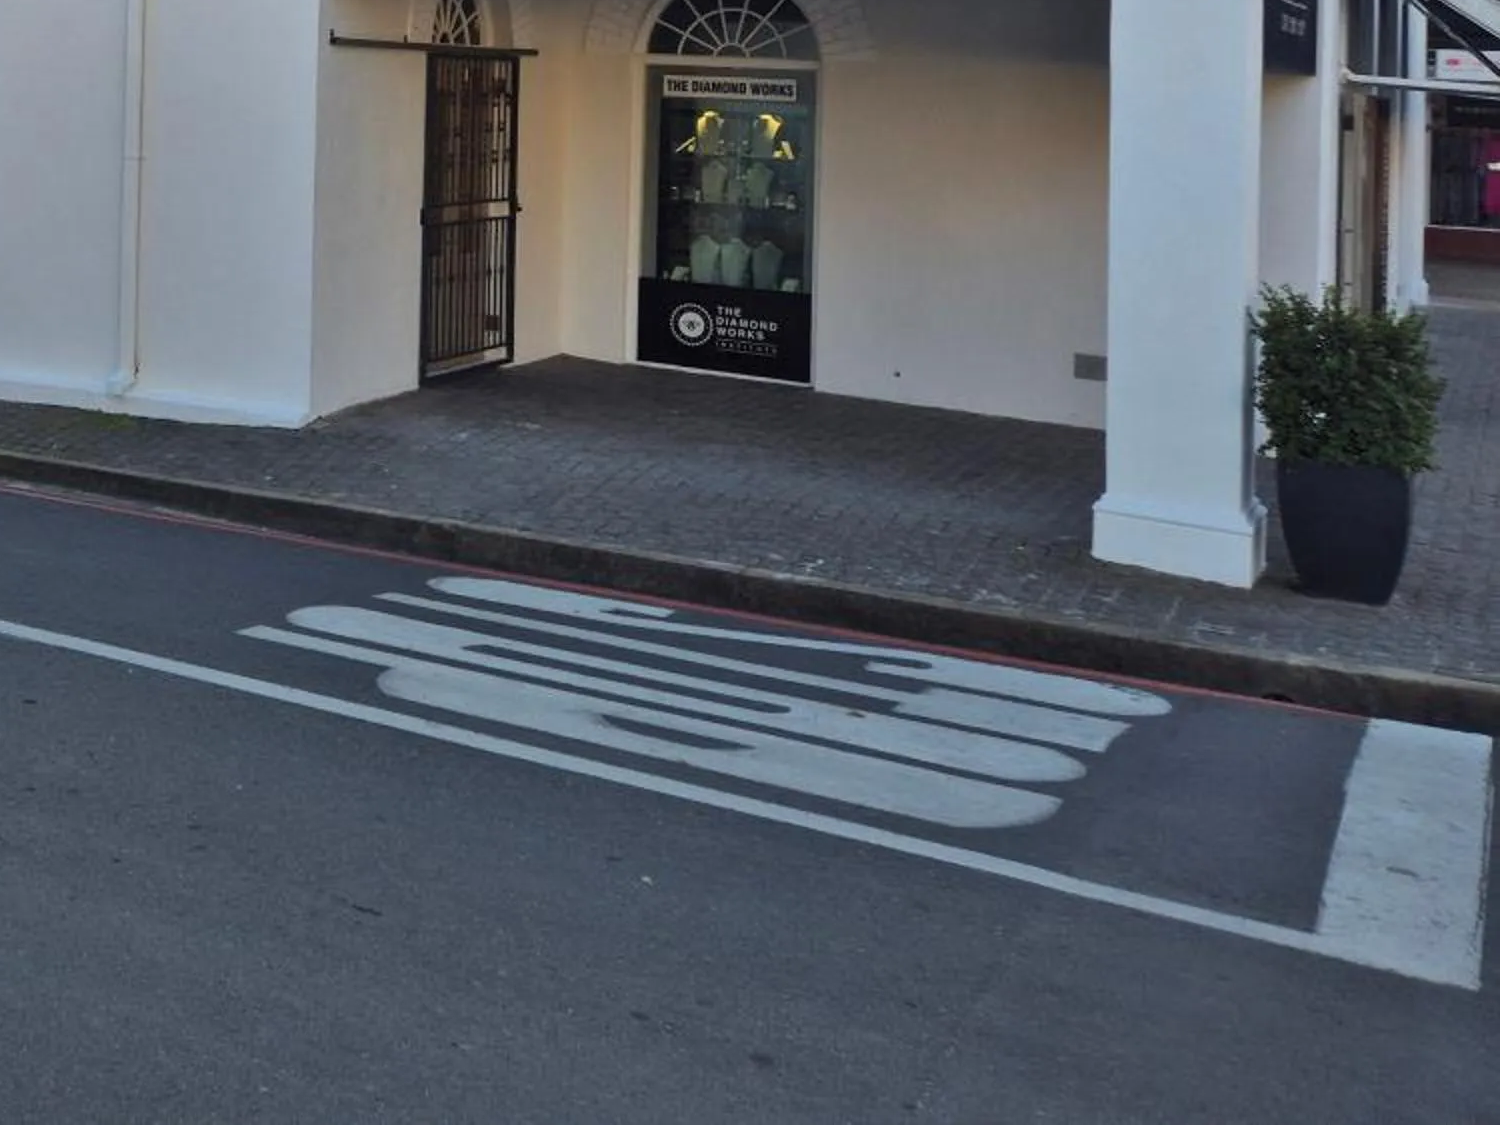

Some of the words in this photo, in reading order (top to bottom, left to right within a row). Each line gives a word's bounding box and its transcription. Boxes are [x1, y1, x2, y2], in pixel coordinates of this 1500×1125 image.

[666, 79, 689, 92] THE
[691, 80, 747, 94] DIAMOND
[750, 82, 794, 97] WORKS
[717, 306, 742, 317] THE
[715, 316, 778, 332] DIAMOND
[715, 327, 765, 341] WORKS
[236, 576, 1172, 829] STOP
